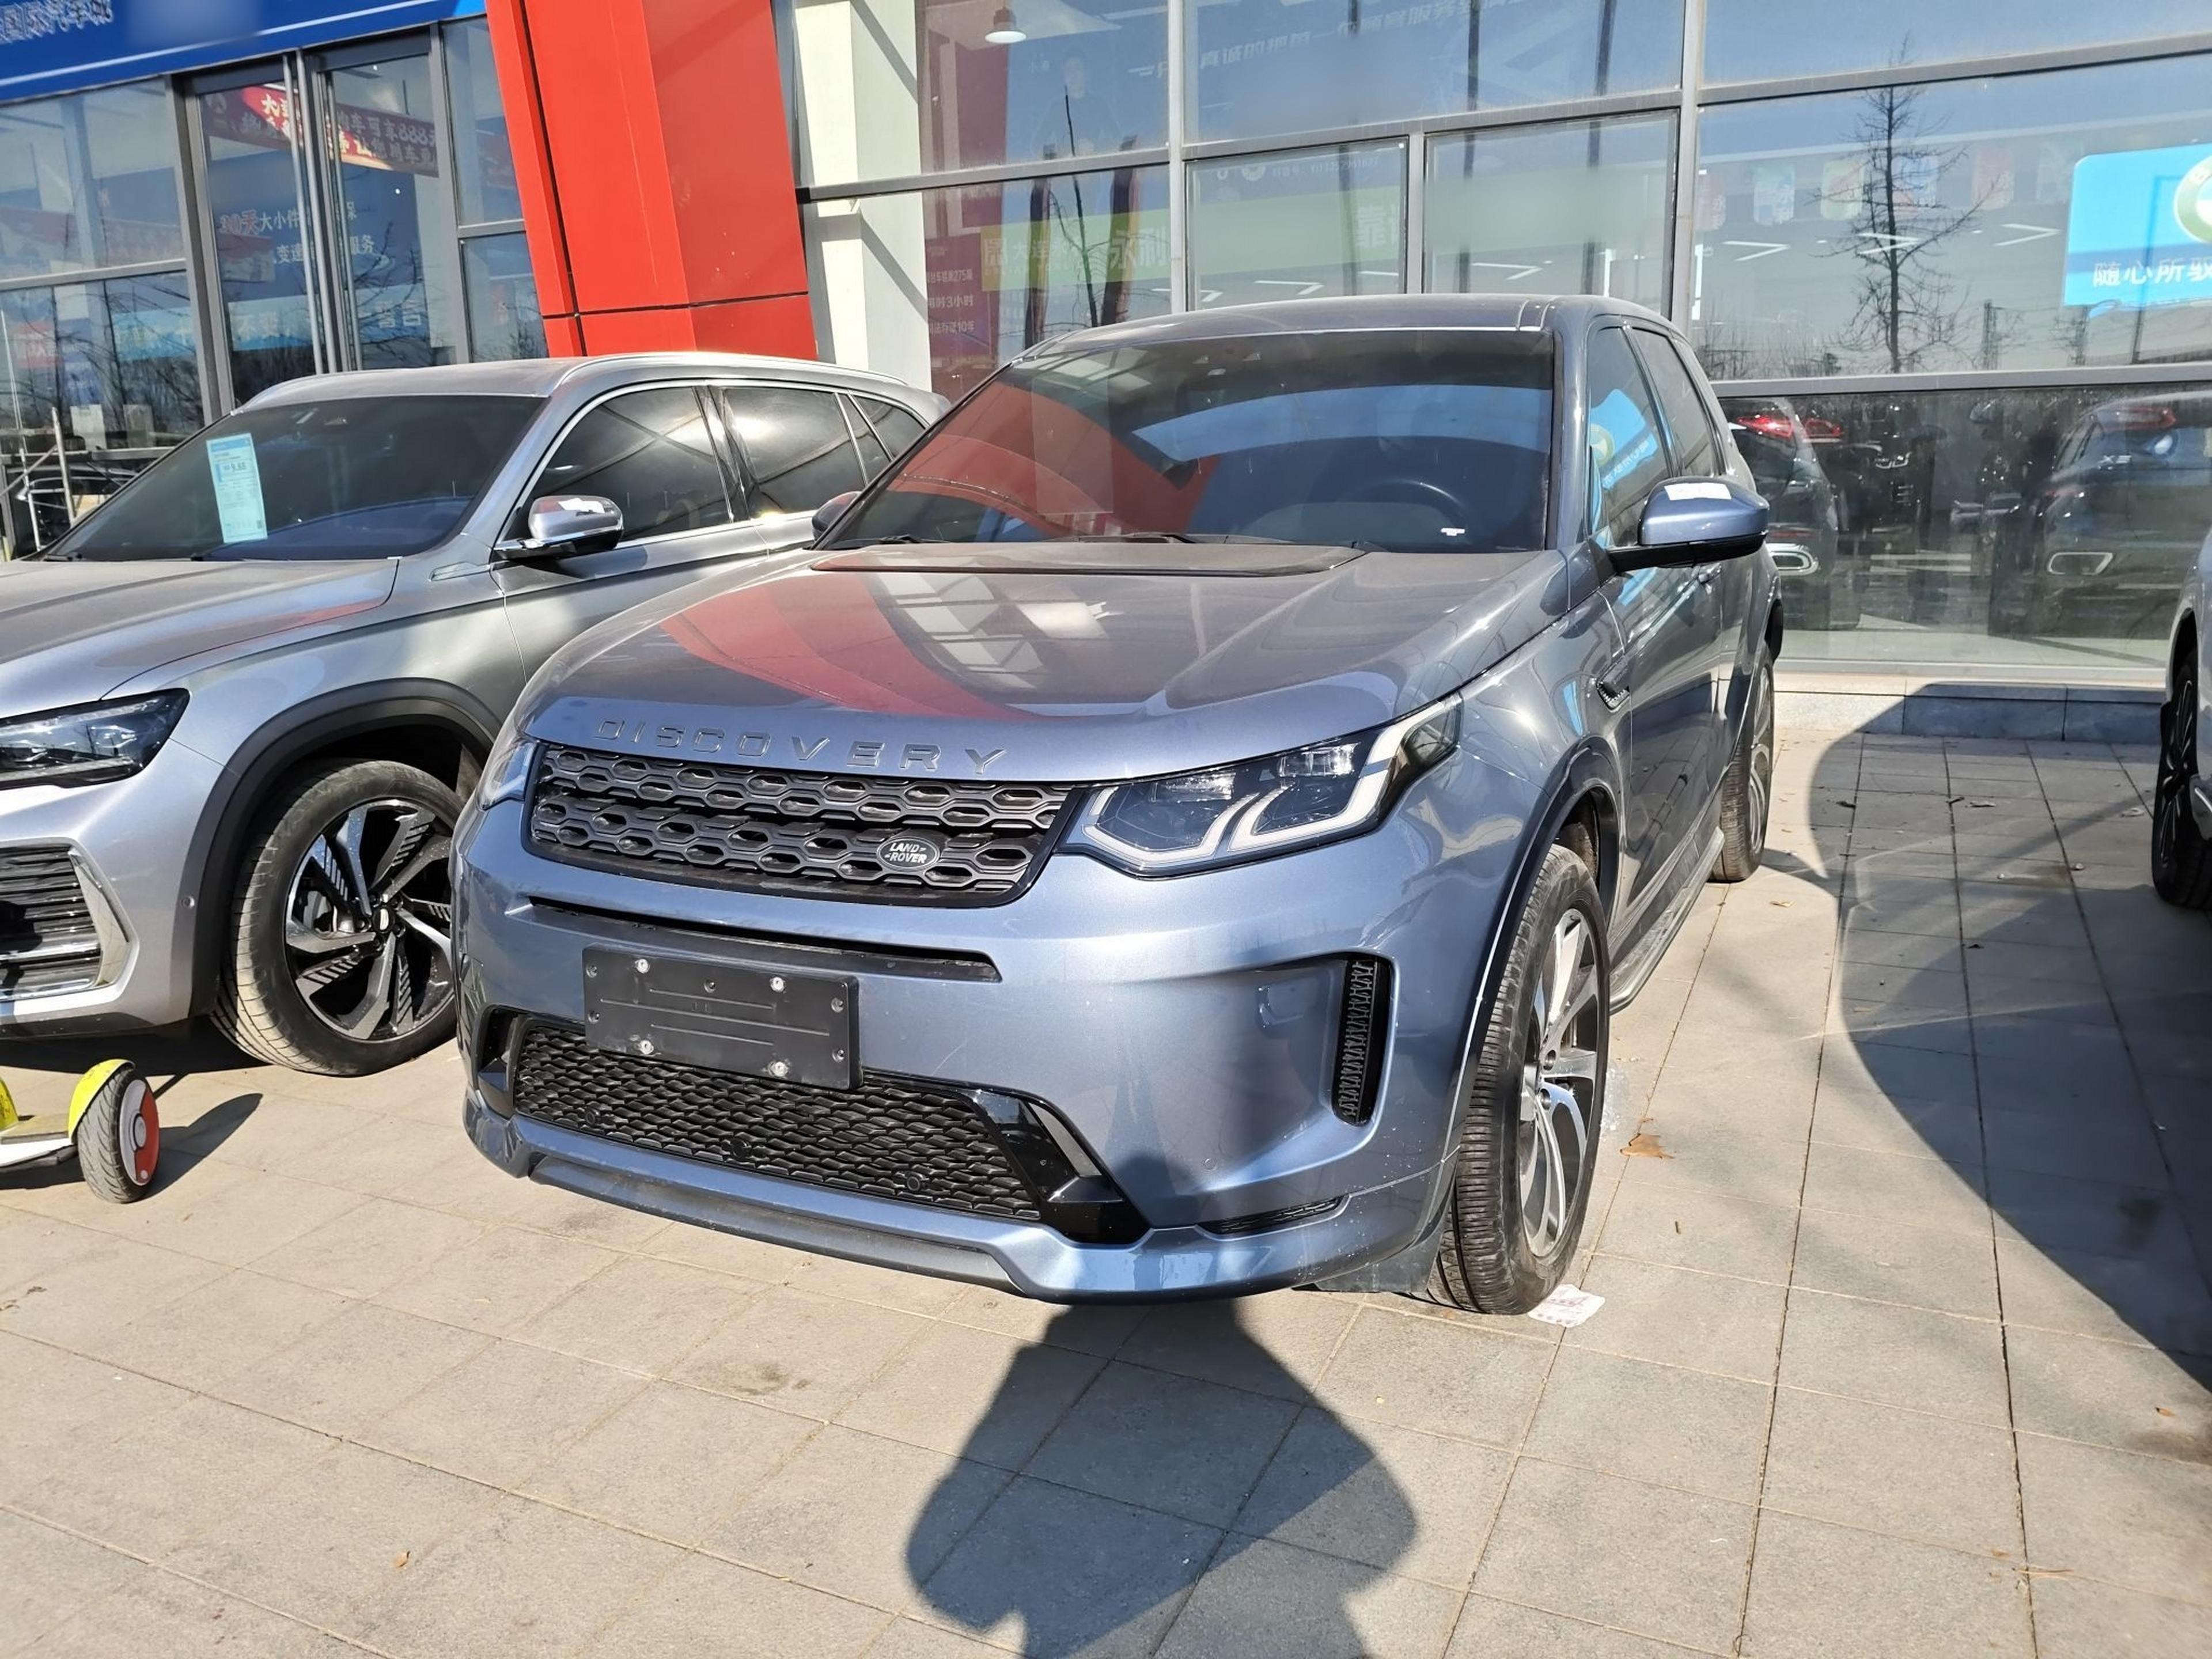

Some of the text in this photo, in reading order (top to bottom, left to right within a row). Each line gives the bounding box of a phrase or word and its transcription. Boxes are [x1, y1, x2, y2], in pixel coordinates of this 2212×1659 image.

[593, 718, 1007, 775] DISCOVERY
[889, 843, 920, 853] LAND
[889, 853, 927, 863] ROVER
